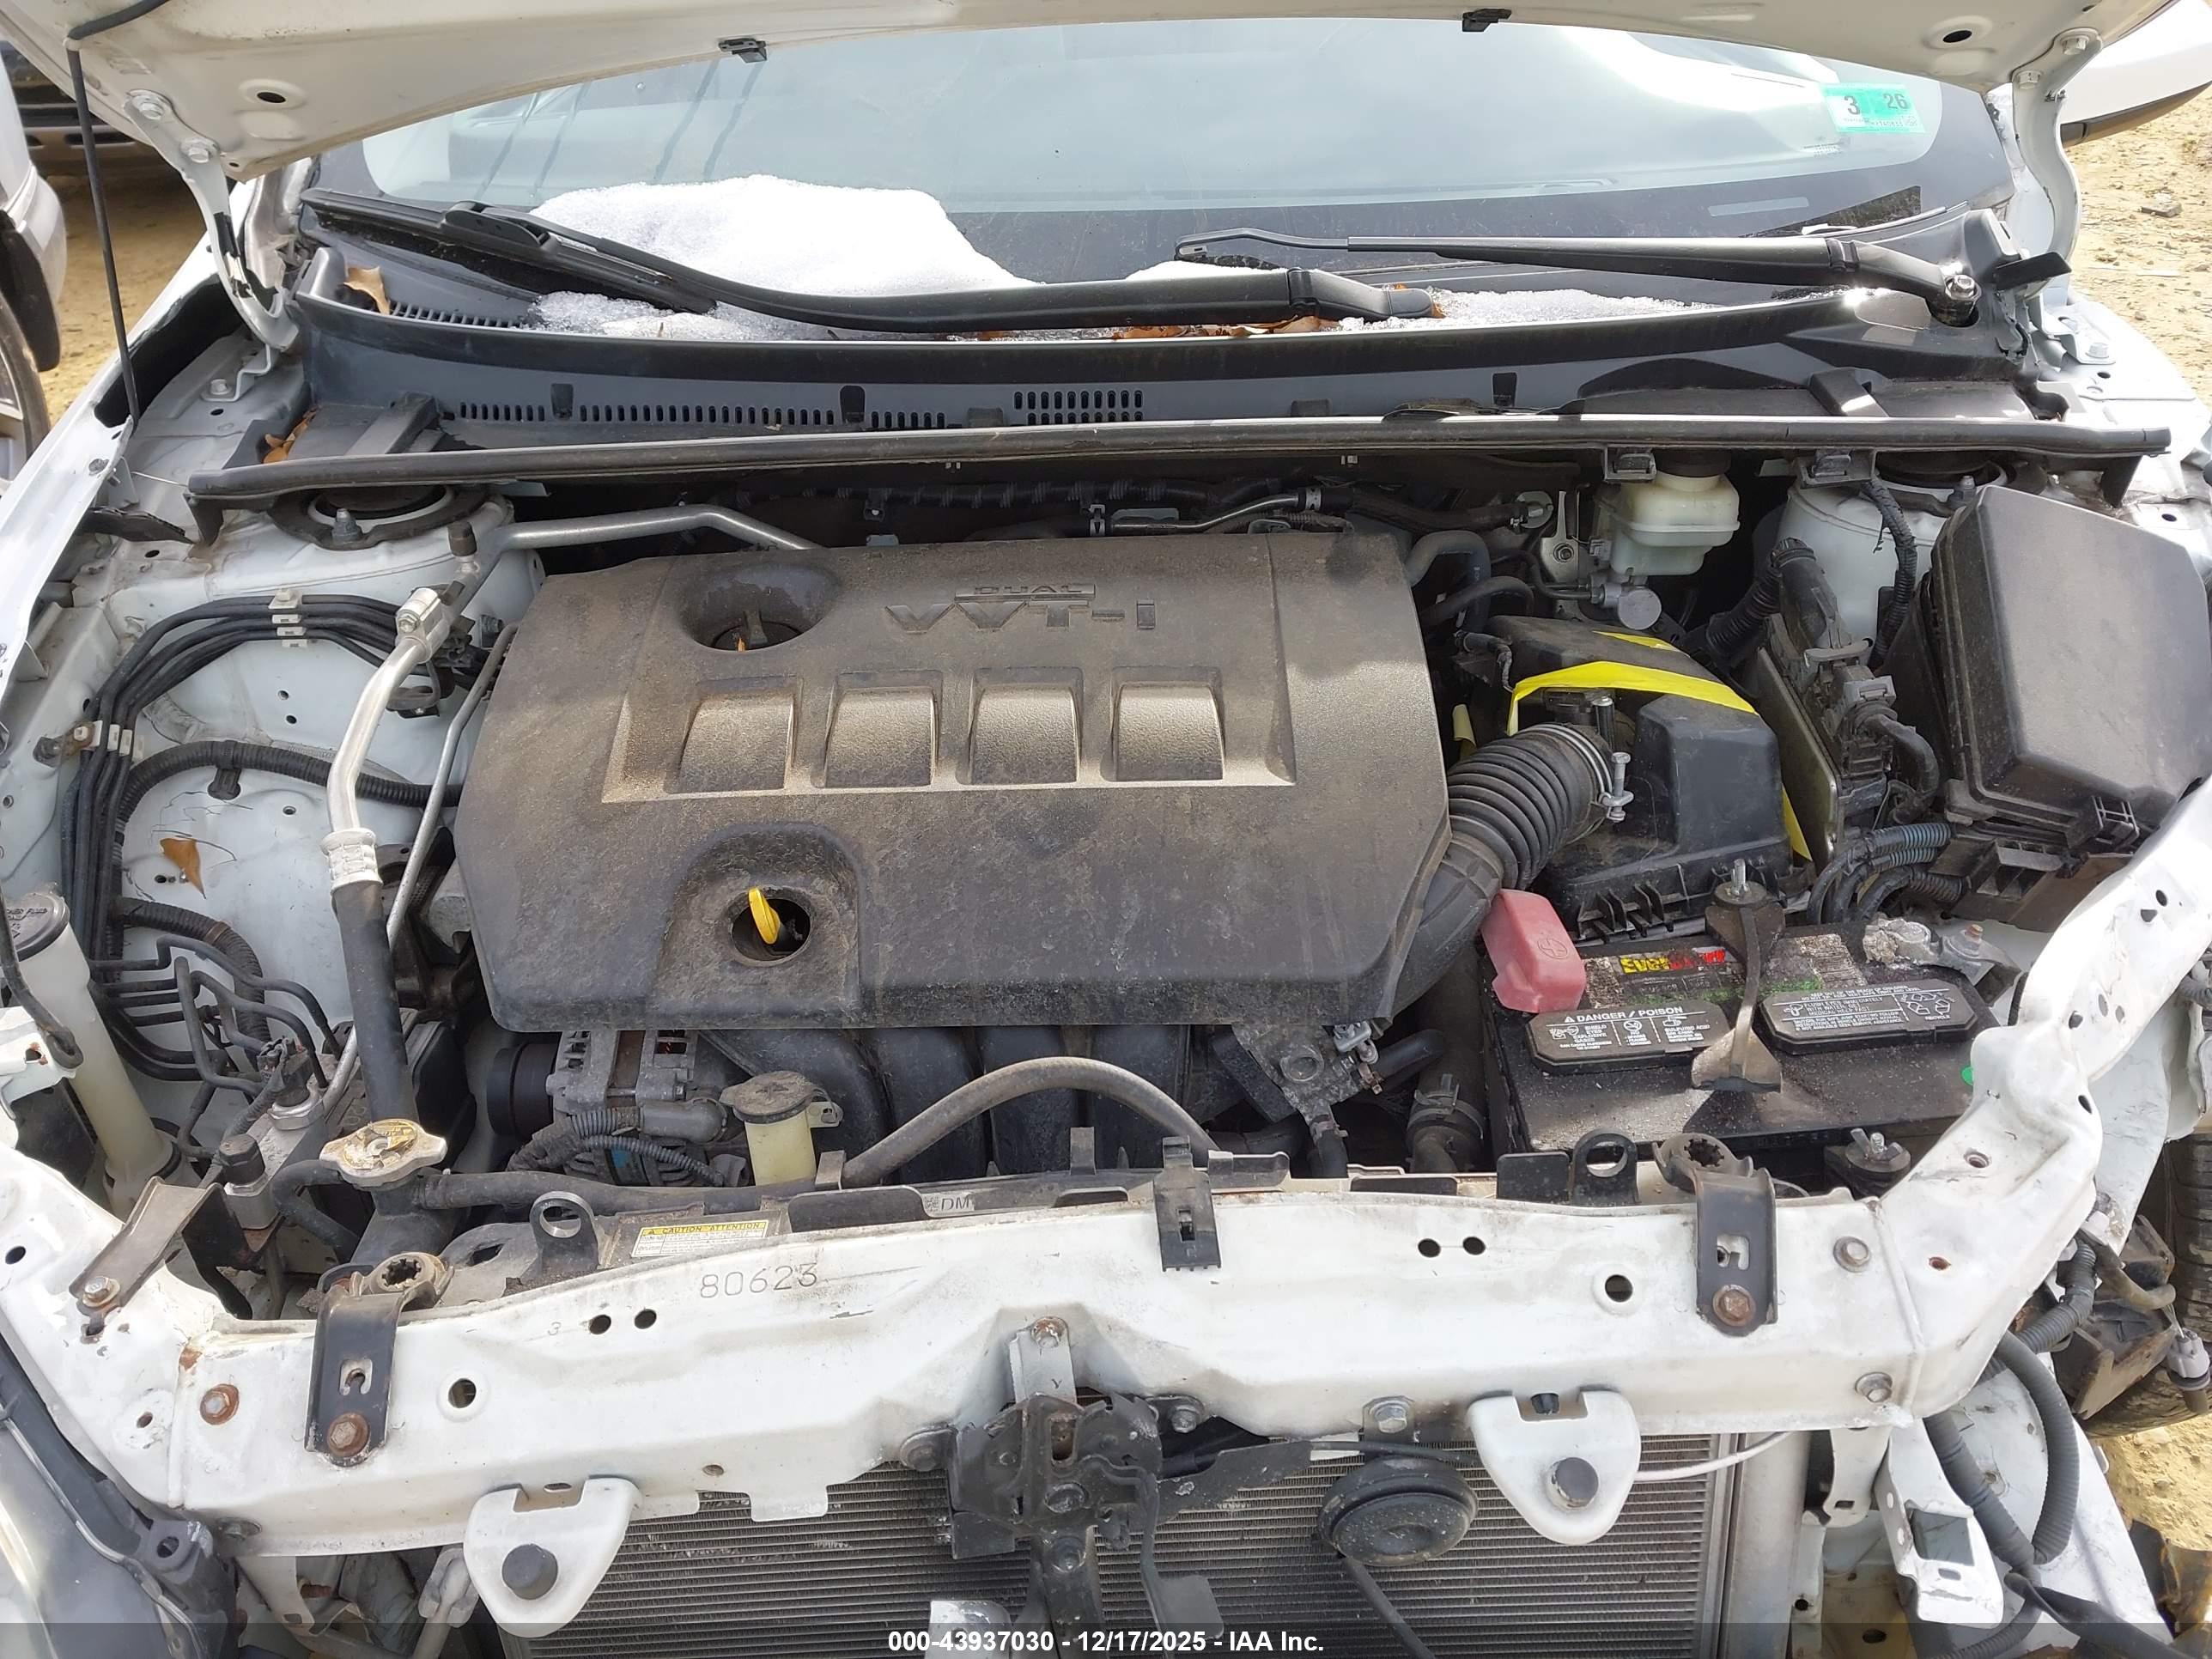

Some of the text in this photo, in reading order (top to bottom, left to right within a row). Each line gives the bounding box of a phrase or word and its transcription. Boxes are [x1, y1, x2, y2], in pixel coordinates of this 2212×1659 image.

[1844, 93, 1909, 115] 3 26
[1577, 1012, 1626, 1022] DANGER
[1638, 1006, 1683, 1017] POISON
[710, 1222, 760, 1231] ATTENTION
[700, 1262, 817, 1298] 80623
